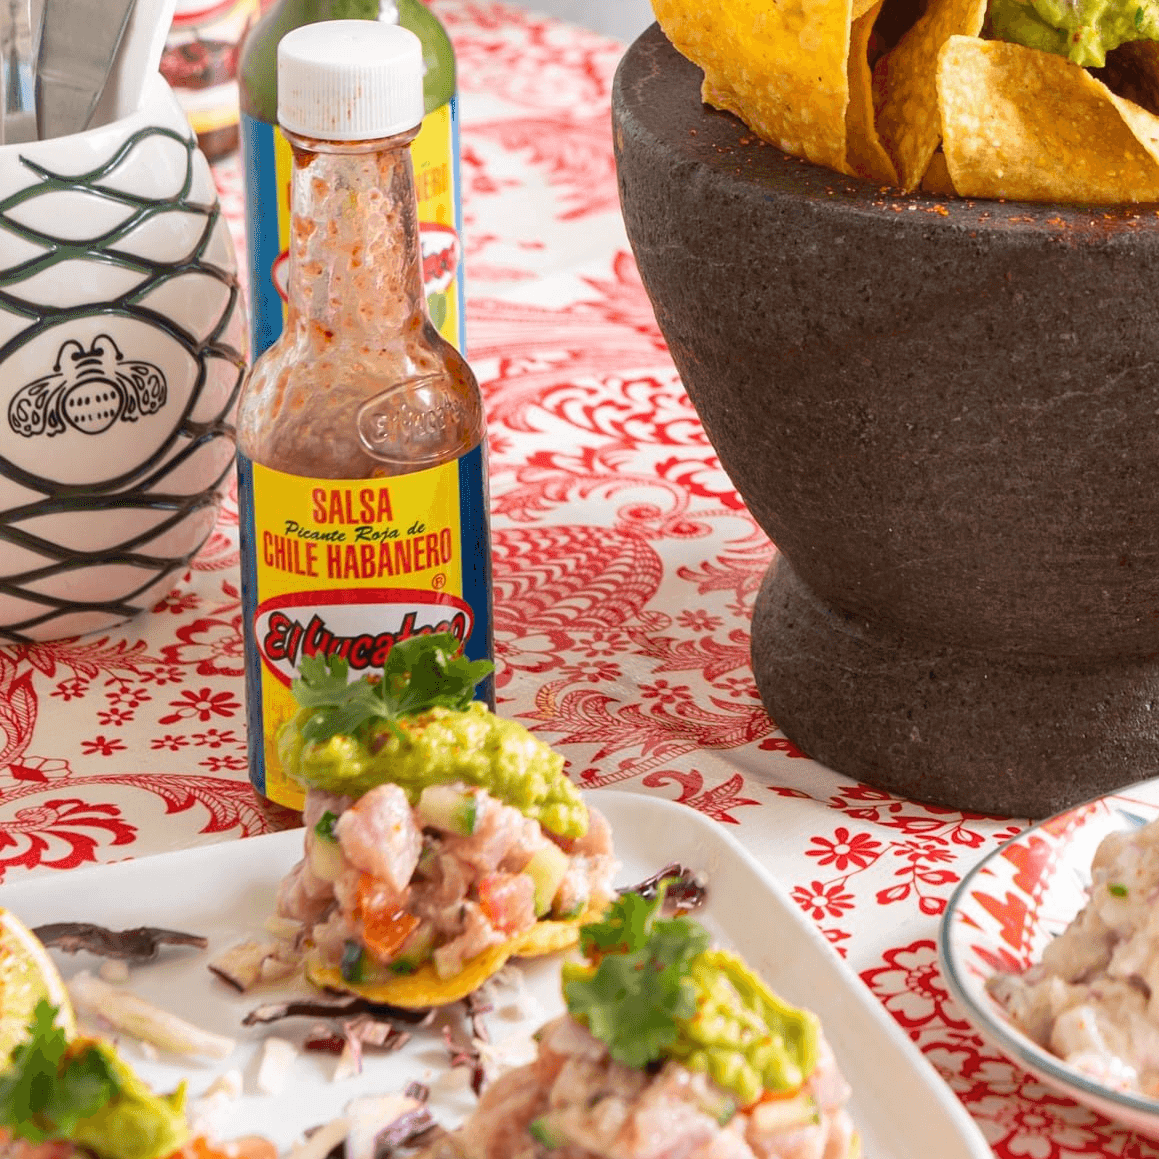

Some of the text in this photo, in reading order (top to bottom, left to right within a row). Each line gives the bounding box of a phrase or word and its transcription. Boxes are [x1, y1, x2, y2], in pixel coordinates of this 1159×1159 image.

[312, 487, 393, 525] SALSA
[263, 527, 452, 579] CHILE HABANERO
[284, 519, 425, 542] Picante Roja de
[264, 611, 466, 670] El Yucato
